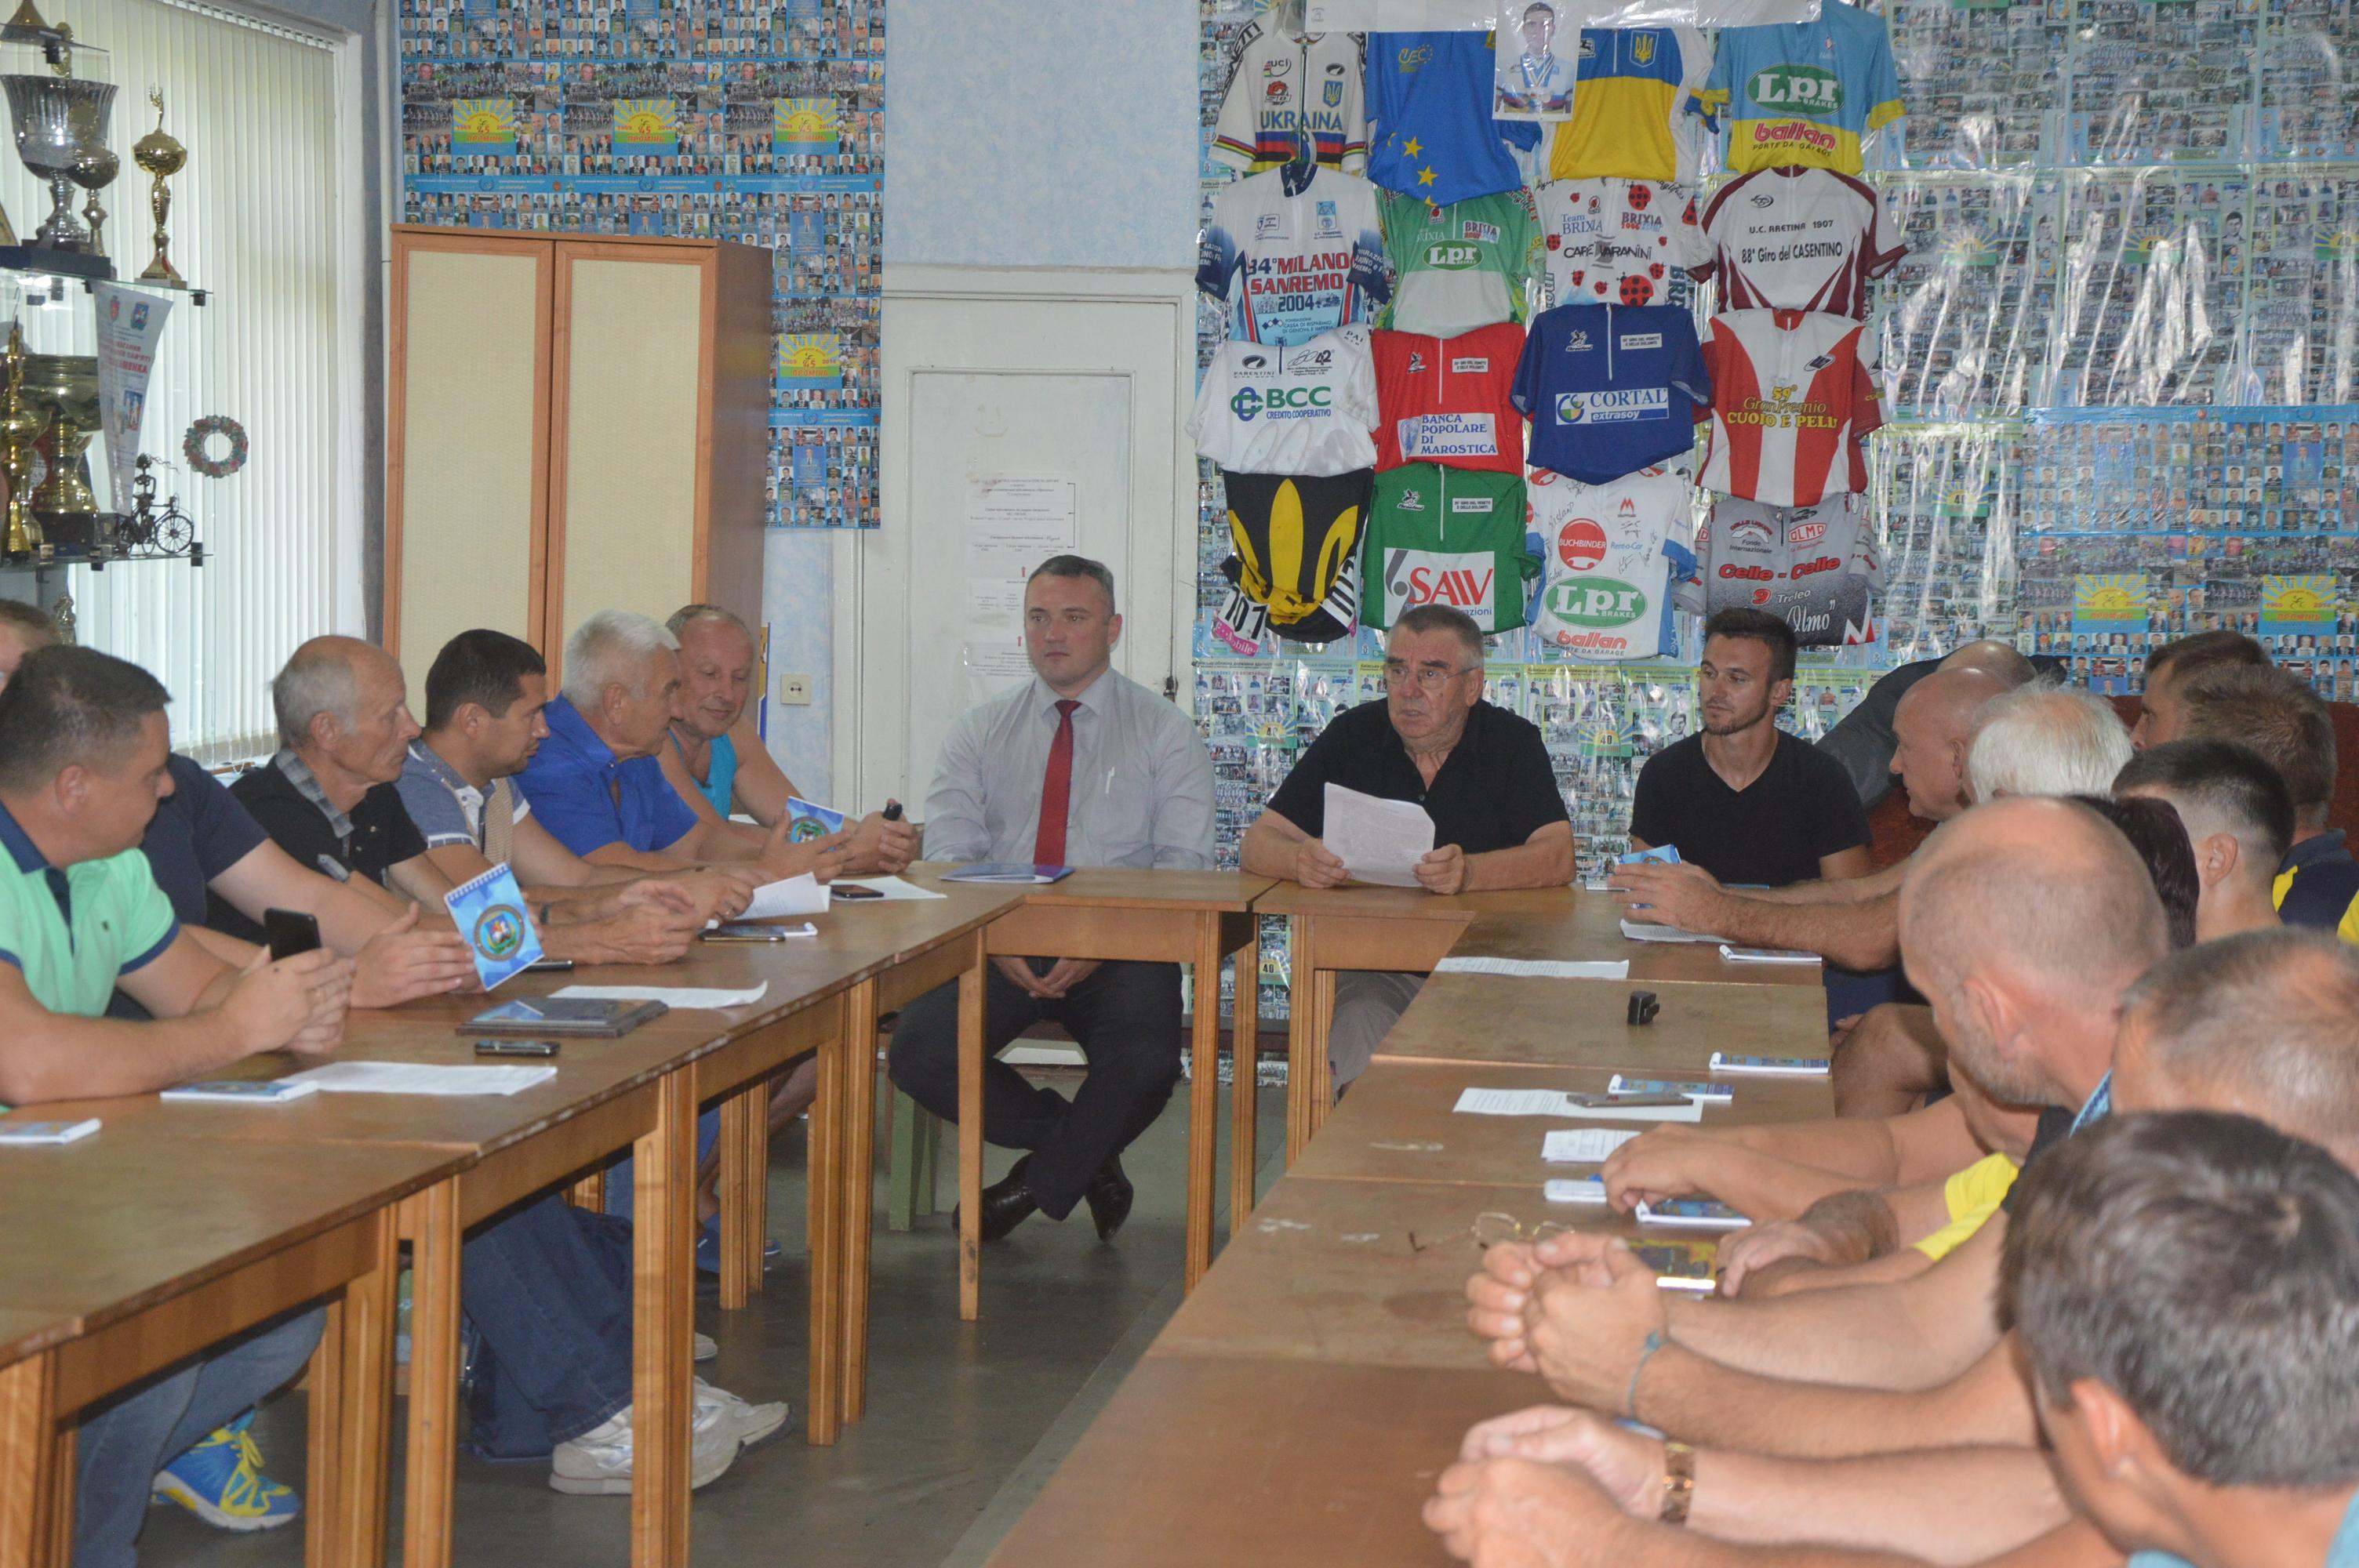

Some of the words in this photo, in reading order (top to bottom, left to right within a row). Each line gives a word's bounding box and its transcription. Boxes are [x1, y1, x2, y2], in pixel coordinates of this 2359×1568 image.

[1756, 73, 1839, 103] Lpr
[1803, 98, 1839, 109] BRAKES
[1259, 110, 1343, 131] UKRAINA
[1754, 122, 1837, 151] ballan
[1561, 213, 1585, 222] Team
[1622, 212, 1663, 225] BRIXIA
[1812, 220, 1834, 228] 1907
[1562, 220, 1603, 235] BRIXIA
[1428, 247, 1478, 265] Lpr
[1757, 247, 1776, 263] Giro
[1779, 245, 1790, 261] del
[1793, 241, 1843, 260] CASENTINO
[1278, 252, 1350, 274] MILANO
[1250, 273, 1344, 296] SANREMO
[1278, 294, 1314, 312] 2004
[1267, 386, 1332, 408] BCC
[1590, 388, 1667, 408] CORTAL
[1267, 411, 1291, 419] CREDITO
[1292, 408, 1332, 419] COOPERATIVO
[1422, 414, 1463, 423] BANCA
[1592, 410, 1640, 421] extrasoy
[1727, 412, 1777, 427] CUOIO
[1780, 416, 1791, 427] E
[1421, 424, 1487, 434] POPOLARE
[1421, 435, 1434, 444] DI
[1421, 445, 1497, 454] MAROSTICA
[1790, 524, 1826, 542] OLMO
[1558, 538, 1607, 549] BUCHBINDER
[1718, 564, 1775, 581] Celle
[1790, 556, 1841, 580] Celle
[1553, 585, 1640, 616] Lpr
[1752, 588, 1772, 604] 9
[1777, 590, 1812, 604] Trofeo
[1556, 630, 1627, 649] ballan
